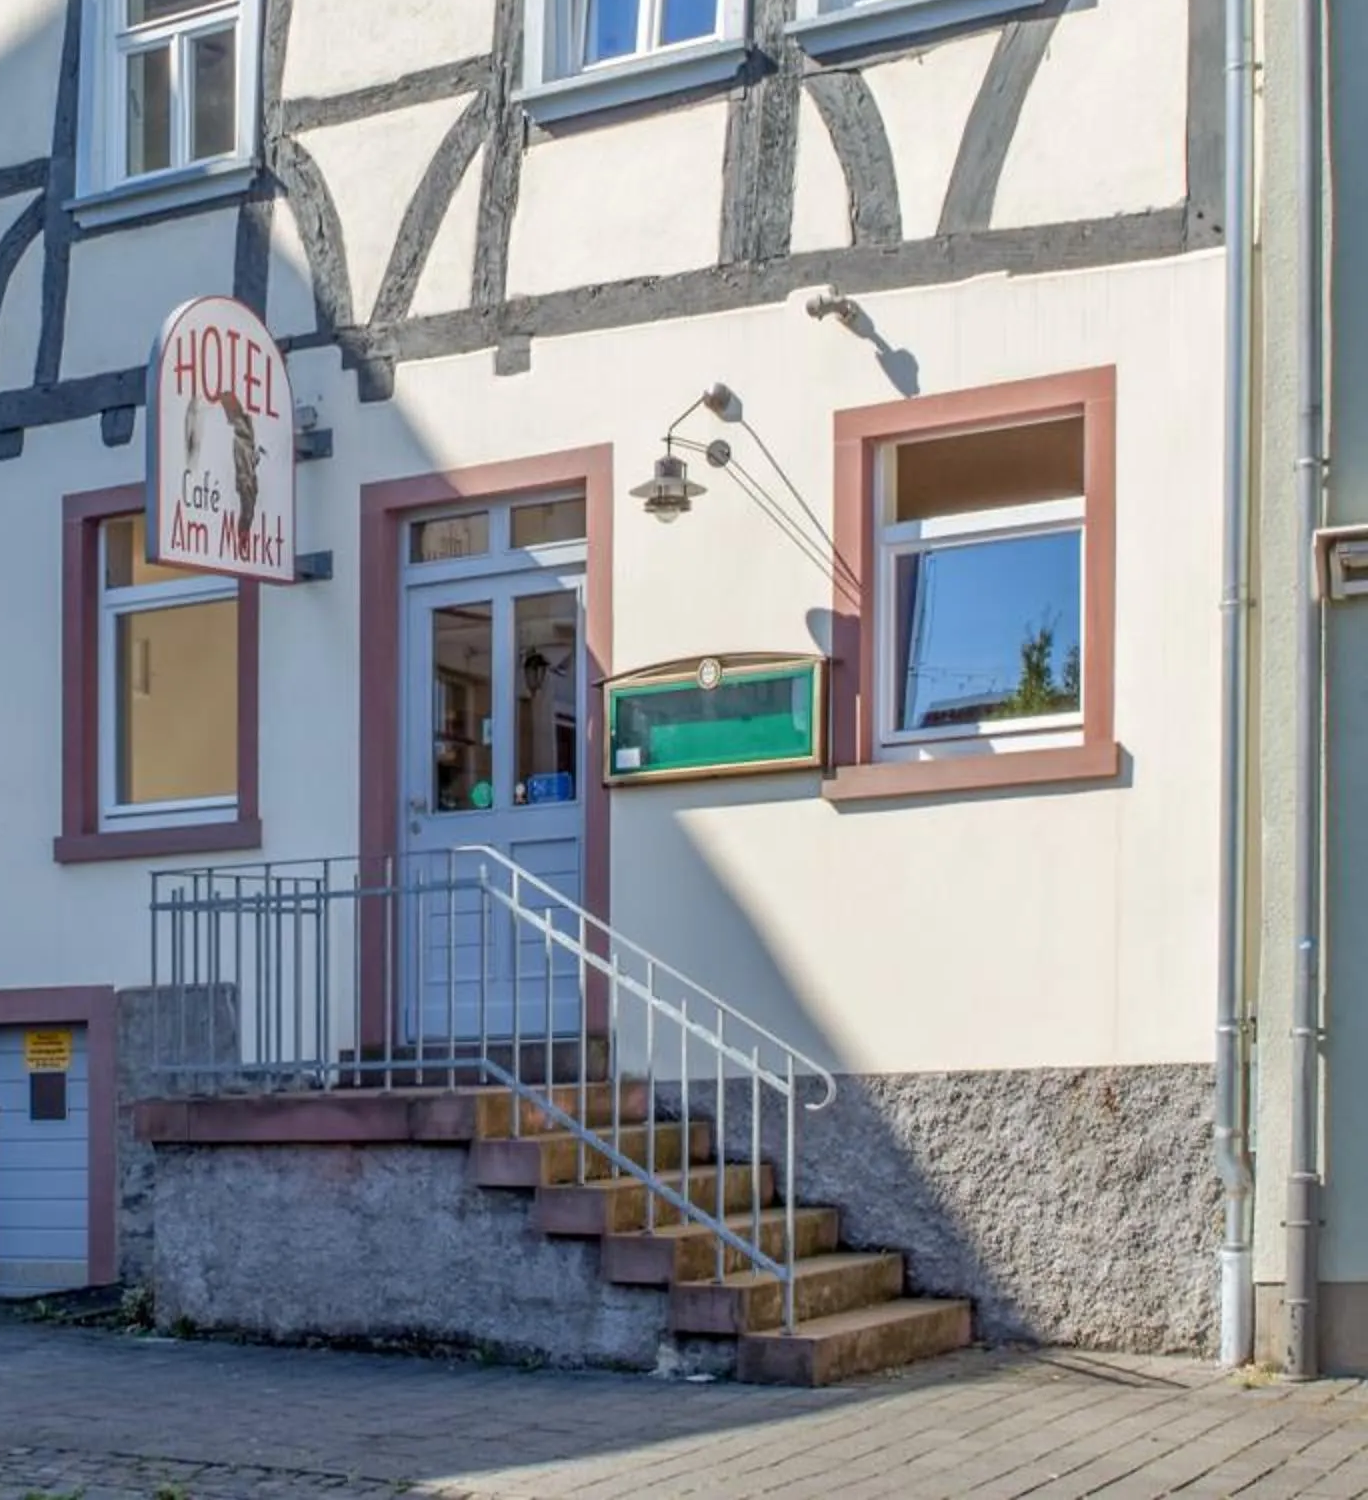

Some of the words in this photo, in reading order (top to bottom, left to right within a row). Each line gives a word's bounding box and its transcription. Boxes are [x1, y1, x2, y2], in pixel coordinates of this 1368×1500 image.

[173, 326, 279, 419] HOTEL
[182, 469, 221, 513] Café
[171, 499, 209, 556] Am
[219, 508, 285, 567] Markt
